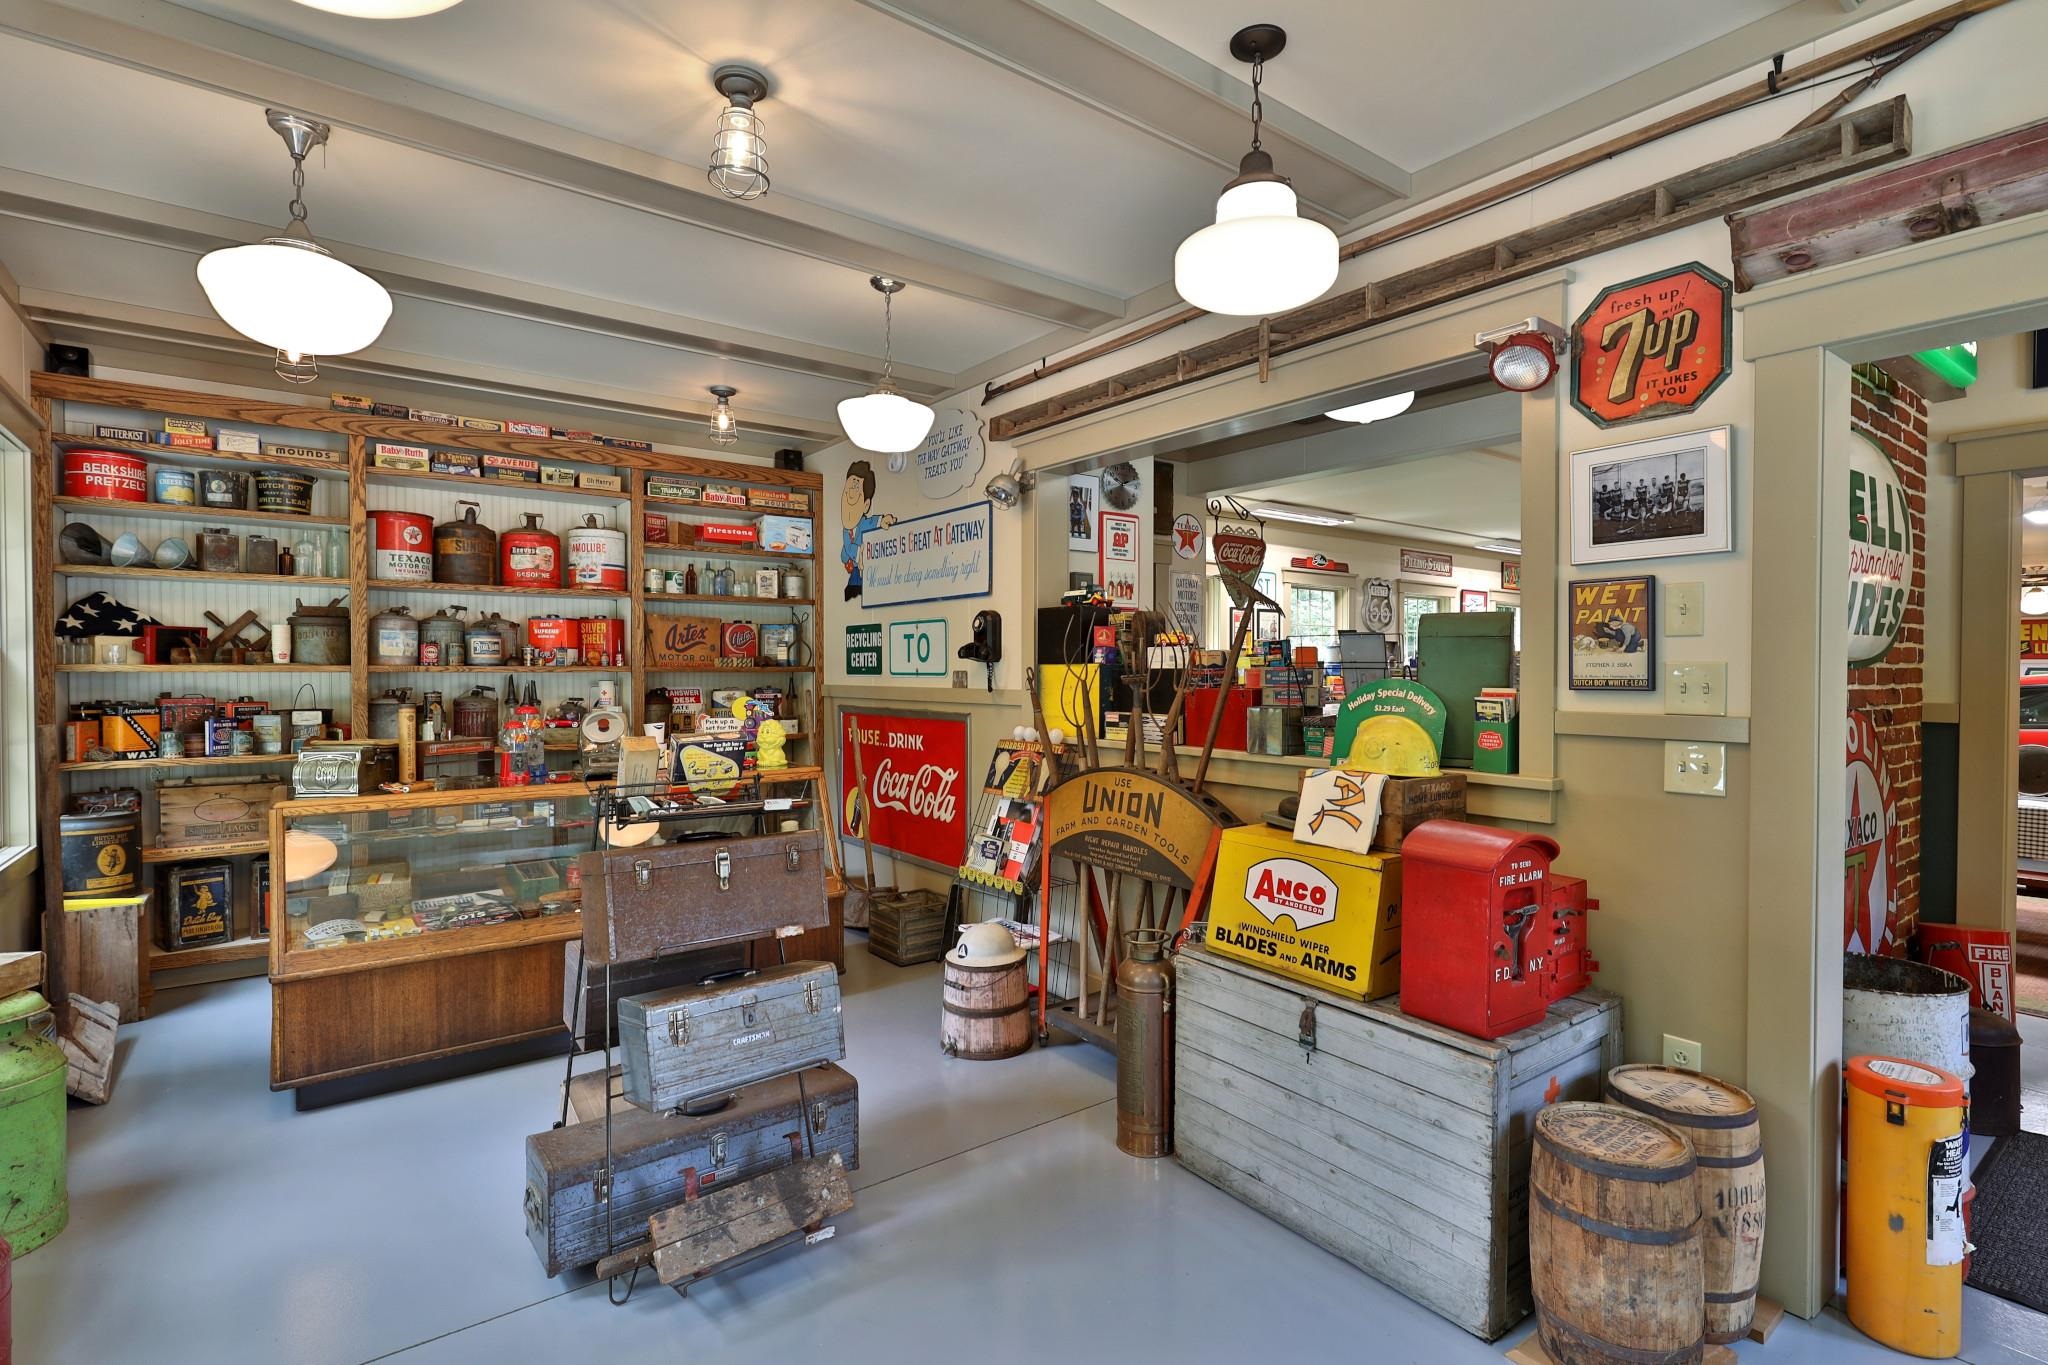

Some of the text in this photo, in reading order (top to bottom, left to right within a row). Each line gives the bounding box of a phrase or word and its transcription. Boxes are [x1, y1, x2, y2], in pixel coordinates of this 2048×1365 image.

[1610, 279, 1691, 314] fresh up!
[1662, 301, 1685, 316] with
[1646, 370, 1698, 390] IT LIKES
[1657, 385, 1688, 399] YOU
[948, 424, 963, 439] LIKE
[174, 437, 211, 447] JOLLY TIME
[275, 447, 331, 459] MOUNDS
[381, 446, 424, 458] Baby Ruth
[917, 436, 972, 465] THE WAY GATEWAY
[500, 456, 536, 469] AVENUE
[924, 462, 947, 479] TREATS
[83, 462, 147, 480] BERKSHIRE
[86, 475, 145, 492] PRETZELS
[259, 482, 285, 490] DUTCH
[285, 498, 307, 507] LEAD
[705, 492, 745, 505] Baby Ruth
[1850, 469, 1910, 554] ELLY
[707, 526, 753, 537] Firestone
[1177, 522, 1200, 531] TEXACO
[866, 519, 985, 560] BUSINESS IS GREAT AT GATEWAY
[389, 553, 431, 565] TEXACO
[1219, 542, 1262, 566] Coca-Cola
[1849, 543, 1906, 581] pringfield
[389, 562, 431, 572] MOTOR OIL
[877, 572, 892, 587] must
[894, 563, 902, 583] be
[903, 562, 923, 588] doing
[924, 554, 959, 583] something
[1176, 578, 1199, 589] GATEWAY
[1178, 590, 1197, 600] MOTORS
[1371, 587, 1388, 597] ROUTE
[1576, 583, 1645, 606] WET
[1174, 602, 1200, 612] CUSTOMER
[1369, 599, 1392, 623] 66
[1848, 581, 1904, 638] IRES
[1575, 607, 1645, 625] PAINT
[580, 622, 607, 634] SILVER
[582, 633, 605, 645] SHELL
[665, 623, 709, 652] Artex
[846, 632, 883, 648] RECYCLING
[903, 632, 930, 663] TO
[659, 653, 713, 662] MOTOR OIL
[851, 652, 877, 668] CENTER
[1574, 679, 1648, 687] DUTCH BOY WHITE-LEAD
[1347, 688, 1436, 716] Holiday Special Delivery
[1374, 704, 1405, 713] $3.29 Each
[848, 727, 924, 751] PUSE... DRINK
[126, 750, 157, 759] WAX
[1114, 777, 1132, 789] USE
[1847, 715, 1898, 836] OLINE
[873, 758, 959, 823] Coca-Cola
[1421, 783, 1450, 793] TEXACO
[1083, 780, 1165, 829] UNION
[1056, 821, 1076, 837] FARM
[1081, 816, 1100, 826] AND
[1106, 816, 1148, 836] GARDEN
[1154, 833, 1190, 865] TOOLS
[1101, 839, 1149, 856] REPAIR HANDLES
[1520, 860, 1532, 868] SEND
[1500, 870, 1543, 887] FIRE ALARM
[1253, 869, 1327, 905] ANCO
[1284, 900, 1323, 915] ANDERSON
[184, 911, 222, 927] Dutch Boy
[1241, 922, 1330, 955] WINDSHIELD WIPER
[1215, 926, 1357, 982] BLADES AND ARMS
[1974, 948, 2009, 961] FIRE
[1990, 967, 2004, 1014] BLAN
[733, 1029, 770, 1046] CRAFTSMAN
